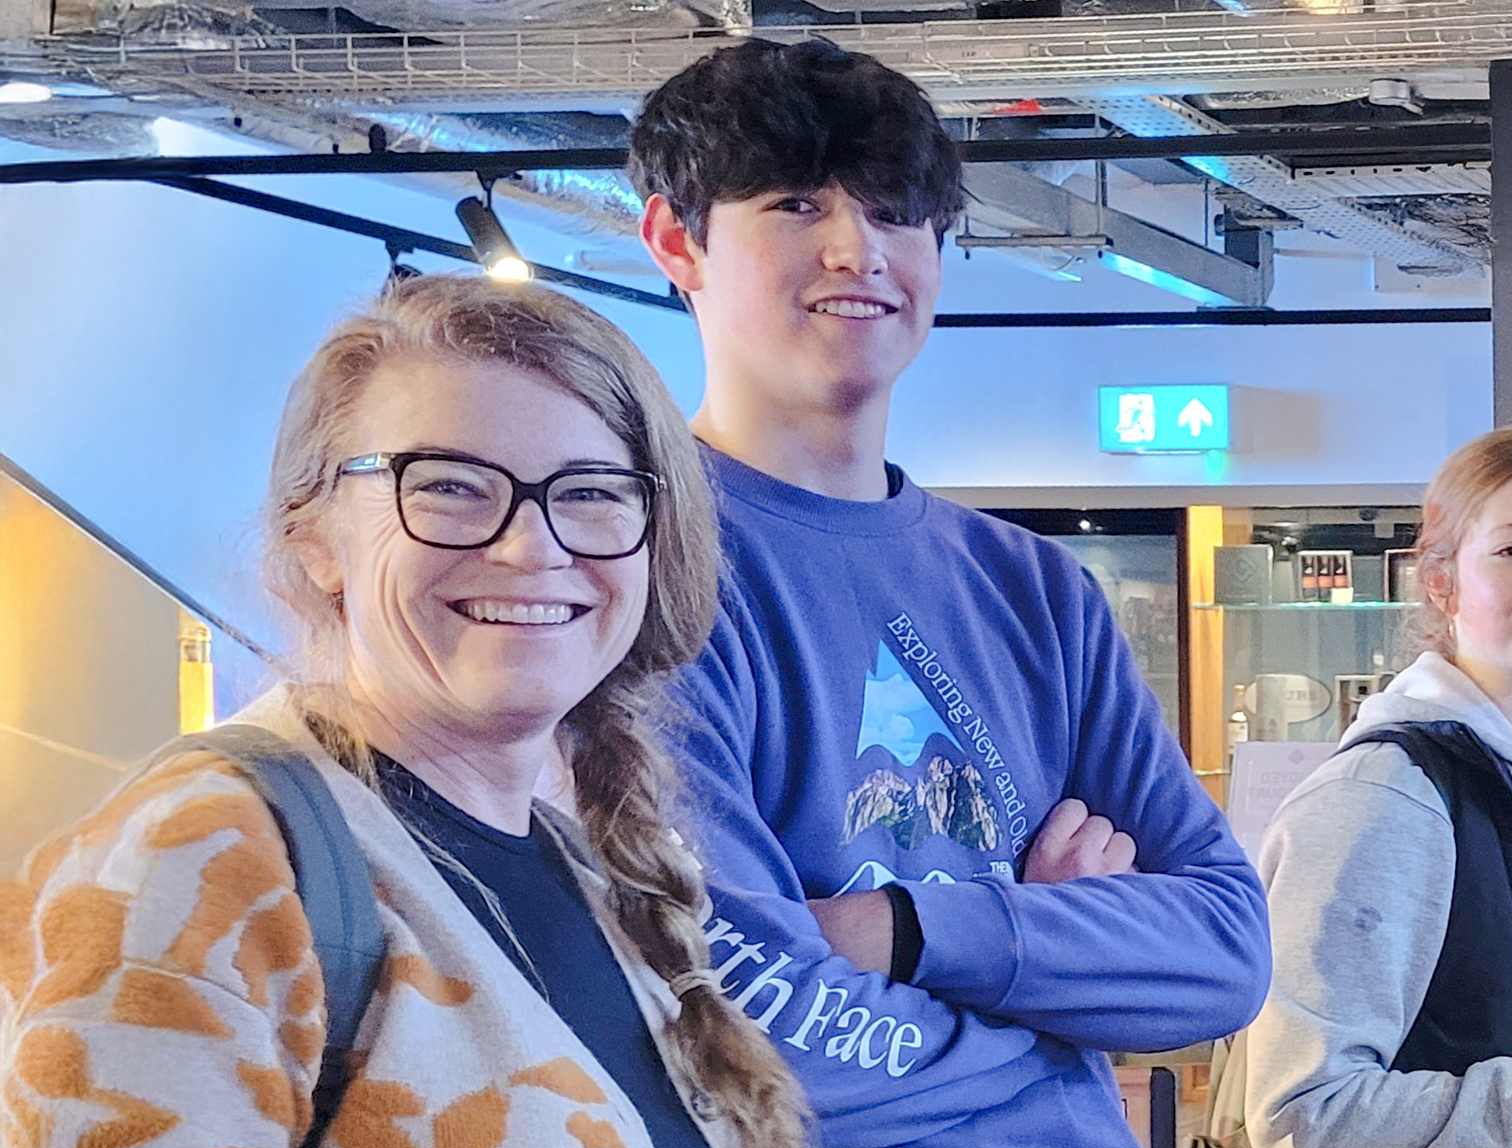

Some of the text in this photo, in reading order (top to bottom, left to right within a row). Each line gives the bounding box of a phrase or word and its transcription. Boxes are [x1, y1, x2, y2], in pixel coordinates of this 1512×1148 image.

[887, 612, 1028, 858] Exploring New and Old
[699, 893, 922, 1077] rth Face
